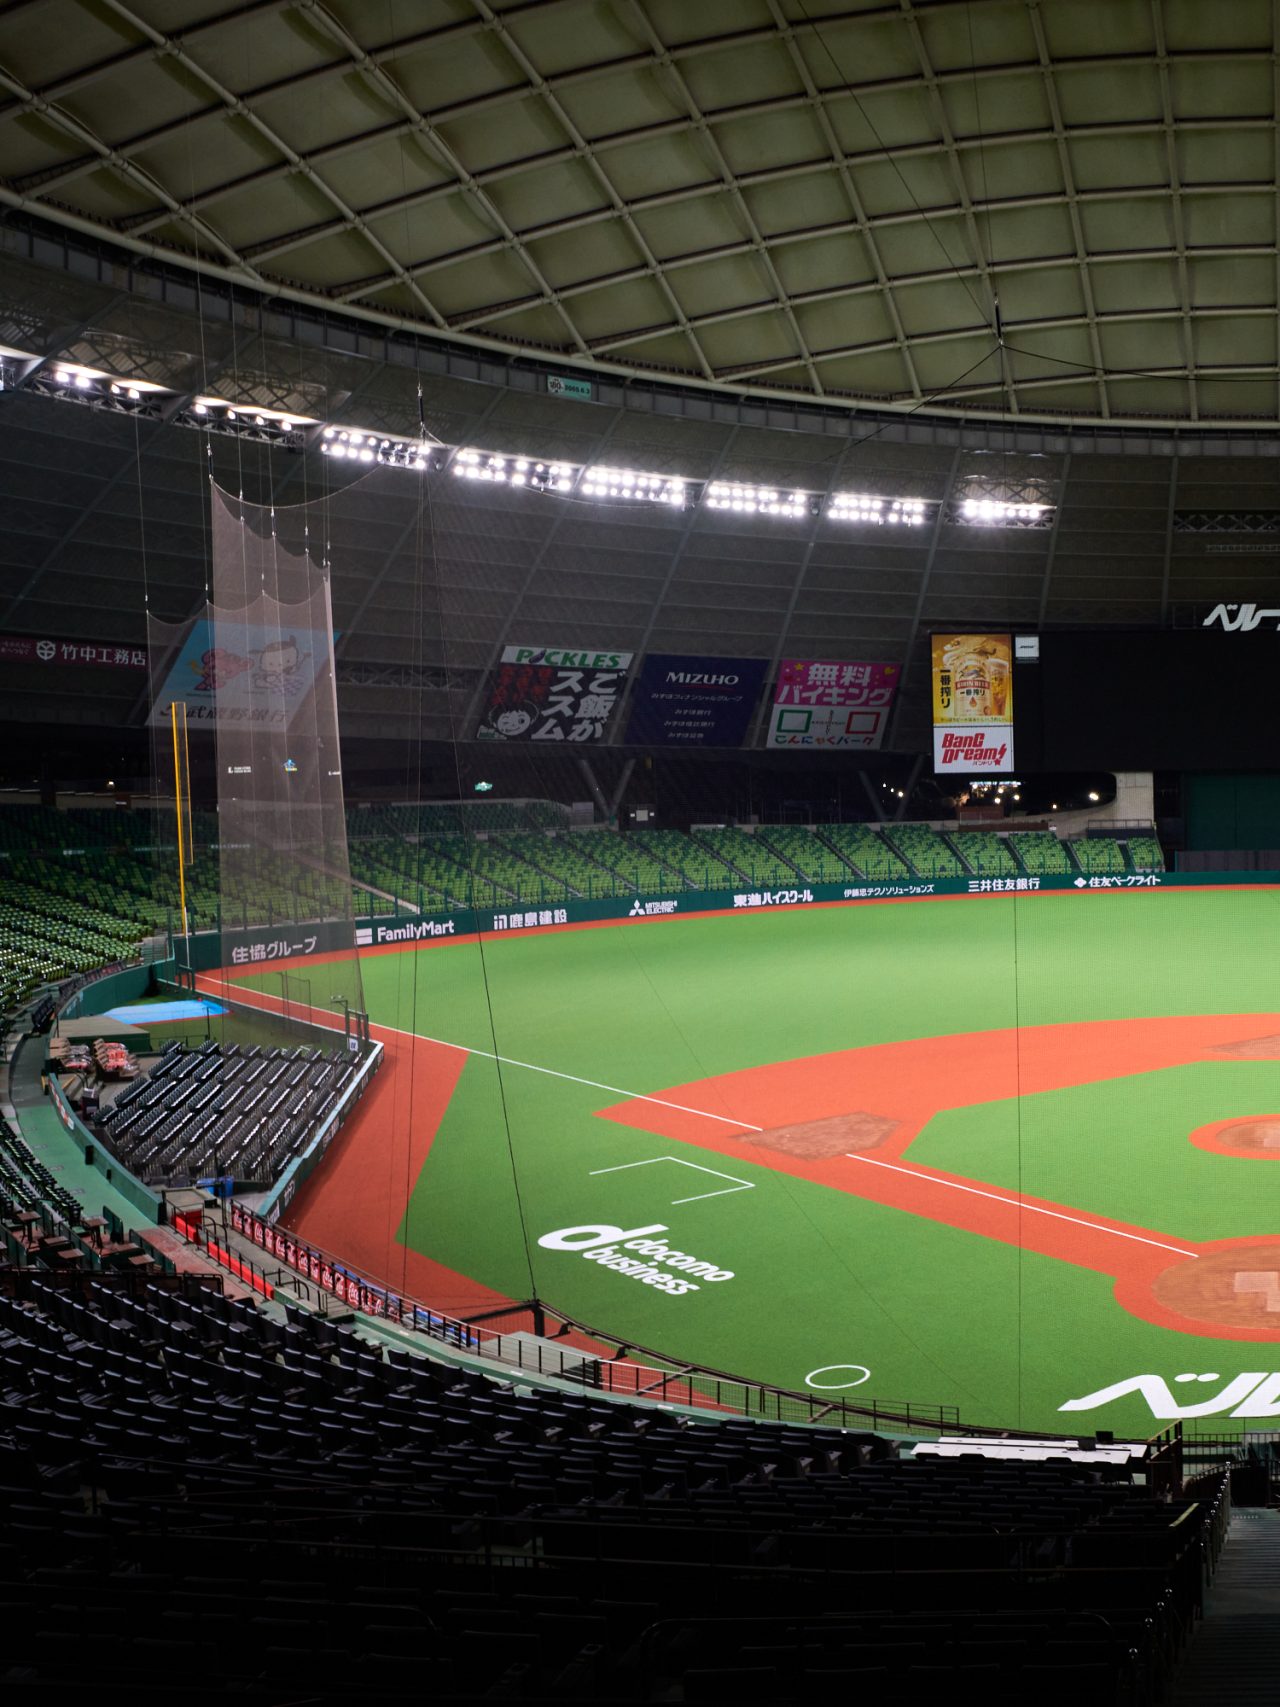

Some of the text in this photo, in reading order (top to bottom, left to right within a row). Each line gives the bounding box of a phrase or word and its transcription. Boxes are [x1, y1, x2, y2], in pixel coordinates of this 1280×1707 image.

[61, 644, 147, 666] 竹中工務店
[516, 650, 621, 668] PICKLES
[666, 671, 740, 686] MIZUHO
[807, 663, 872, 687] 無料
[778, 684, 892, 705] バイキング
[940, 668, 951, 709] 一番搾り
[530, 671, 585, 741] ススム
[566, 670, 627, 742] ご飯が
[775, 735, 875, 745] こんにゃくパーク
[844, 884, 934, 898] 伊藤忠テクノソリューションズ
[968, 878, 1040, 892] 三井住友銀行
[1089, 876, 1161, 888] 住友ベークライト
[733, 889, 814, 907] 東進ハイスクール
[510, 909, 567, 929] 鹿島建設
[378, 920, 455, 942] FamilyMart
[232, 936, 317, 964] 住協グループ
[582, 1245, 700, 1295] business
[624, 1239, 735, 1282] docomo
